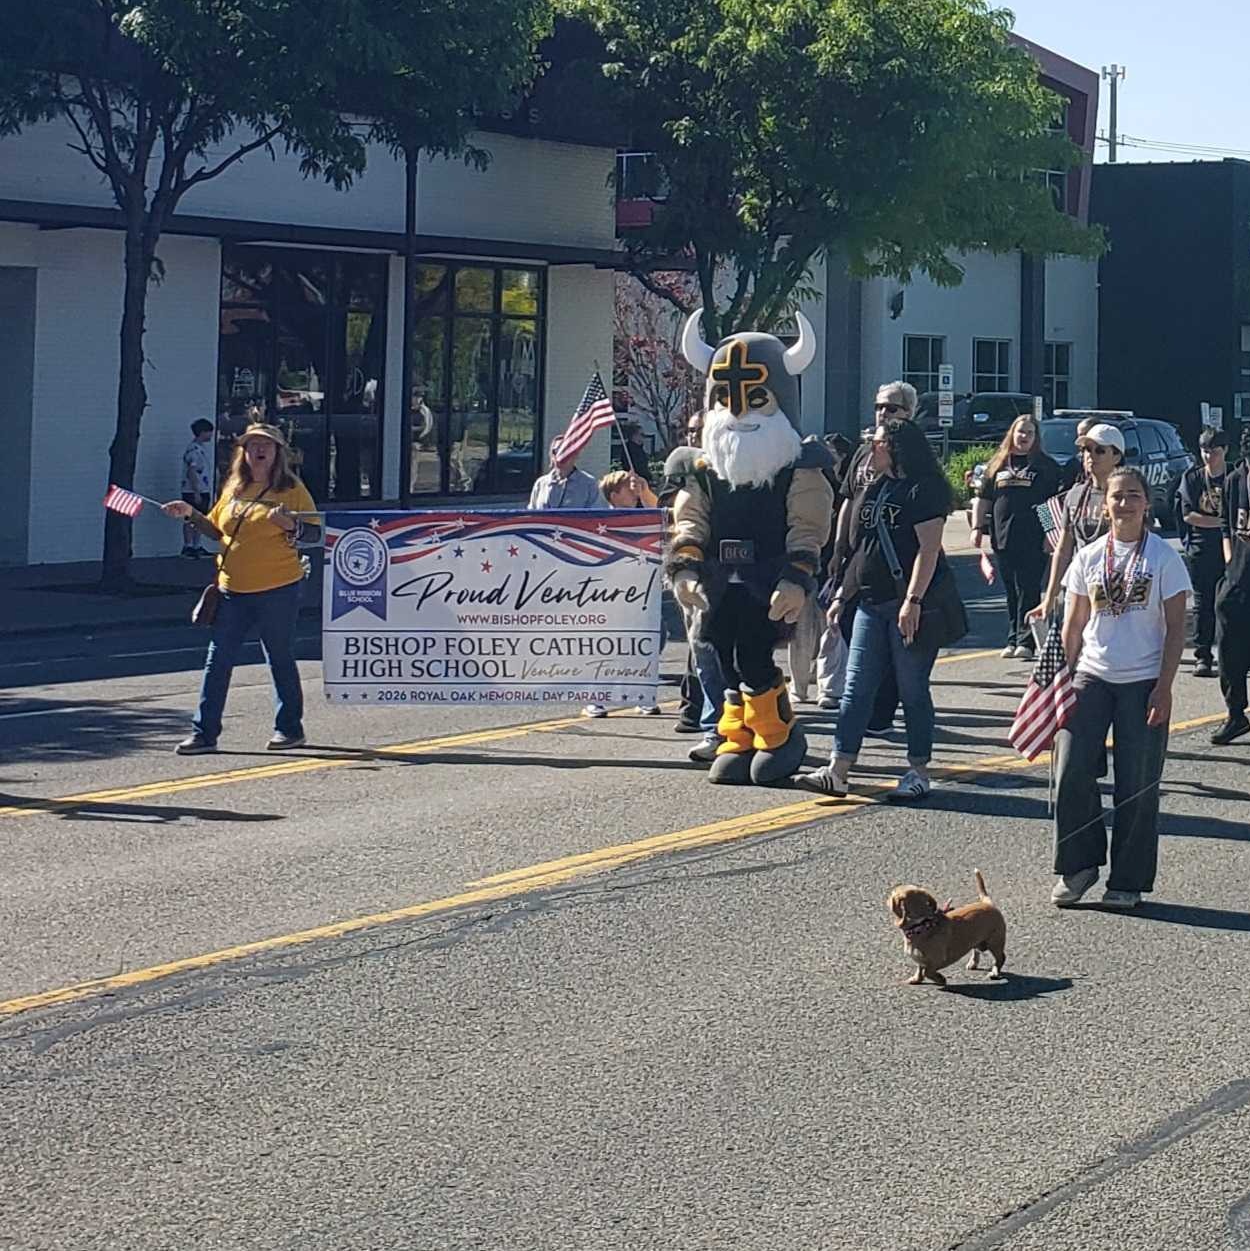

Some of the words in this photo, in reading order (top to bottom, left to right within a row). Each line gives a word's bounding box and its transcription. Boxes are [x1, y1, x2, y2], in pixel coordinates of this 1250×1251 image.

[391, 570, 512, 611] Proud
[514, 568, 658, 611] Venture!
[456, 613, 608, 626] WWW.BISHOPFOLEY.ORG
[344, 637, 437, 656] BISHOP
[444, 637, 522, 656] FOLEY
[529, 637, 653, 656] CATHOLIC
[341, 659, 403, 678] HIGH
[411, 659, 516, 678] SCHOOL
[520, 660, 583, 679] Venture
[377, 690, 407, 701] 2026
[410, 690, 448, 701] ROYAL
[450, 690, 477, 701] OAK
[479, 690, 540, 702] MEMORIAL
[542, 690, 565, 702] DAY
[567, 690, 613, 702] PARADE
